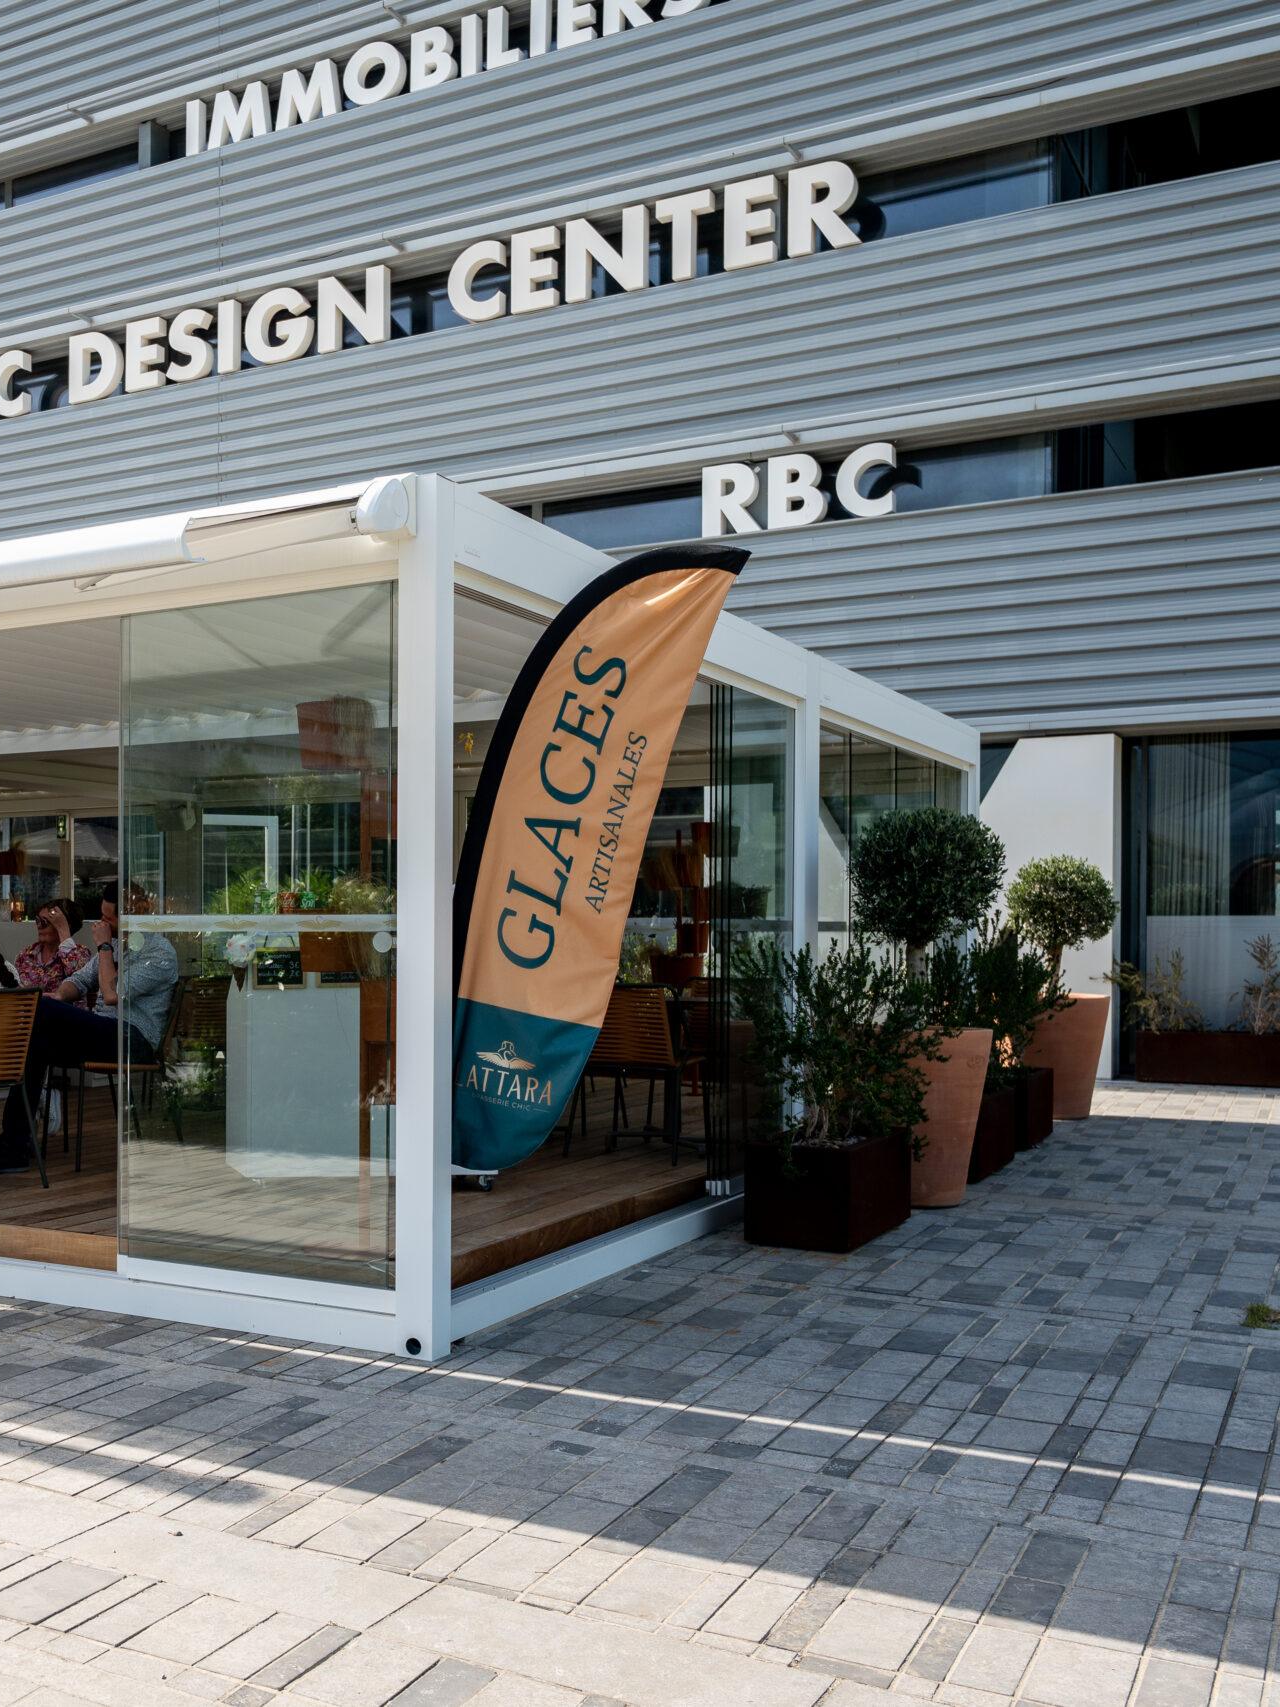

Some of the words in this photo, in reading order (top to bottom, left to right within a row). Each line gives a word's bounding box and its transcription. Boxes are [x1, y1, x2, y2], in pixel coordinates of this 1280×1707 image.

[185, 0, 710, 157] IMMOBILIER
[68, 264, 391, 406] DESIGN
[447, 160, 862, 323] CENTER
[701, 441, 897, 538] RBC
[496, 644, 629, 971] GLACES
[584, 730, 649, 914] ARTISANALES
